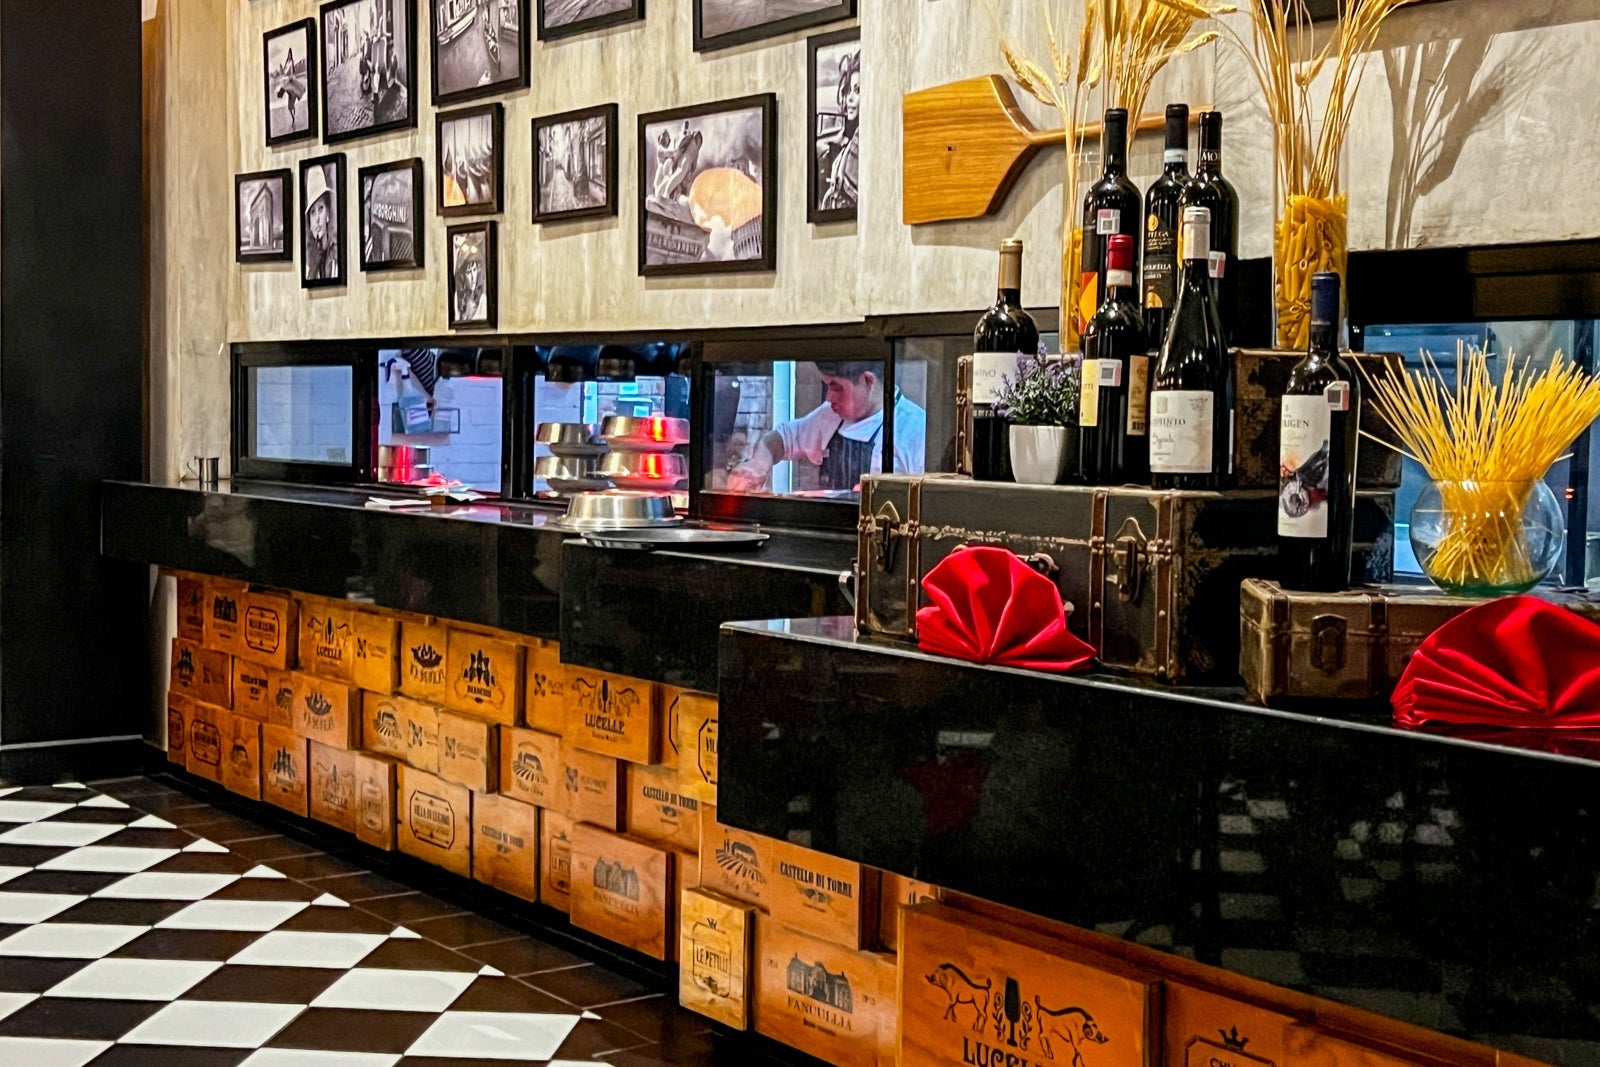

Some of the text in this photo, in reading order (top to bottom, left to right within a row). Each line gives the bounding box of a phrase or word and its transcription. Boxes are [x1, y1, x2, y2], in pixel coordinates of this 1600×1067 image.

[585, 712, 625, 736] LUCELLE
[780, 861, 853, 899] CASTELLO DI TORRE
[696, 947, 705, 965] LE
